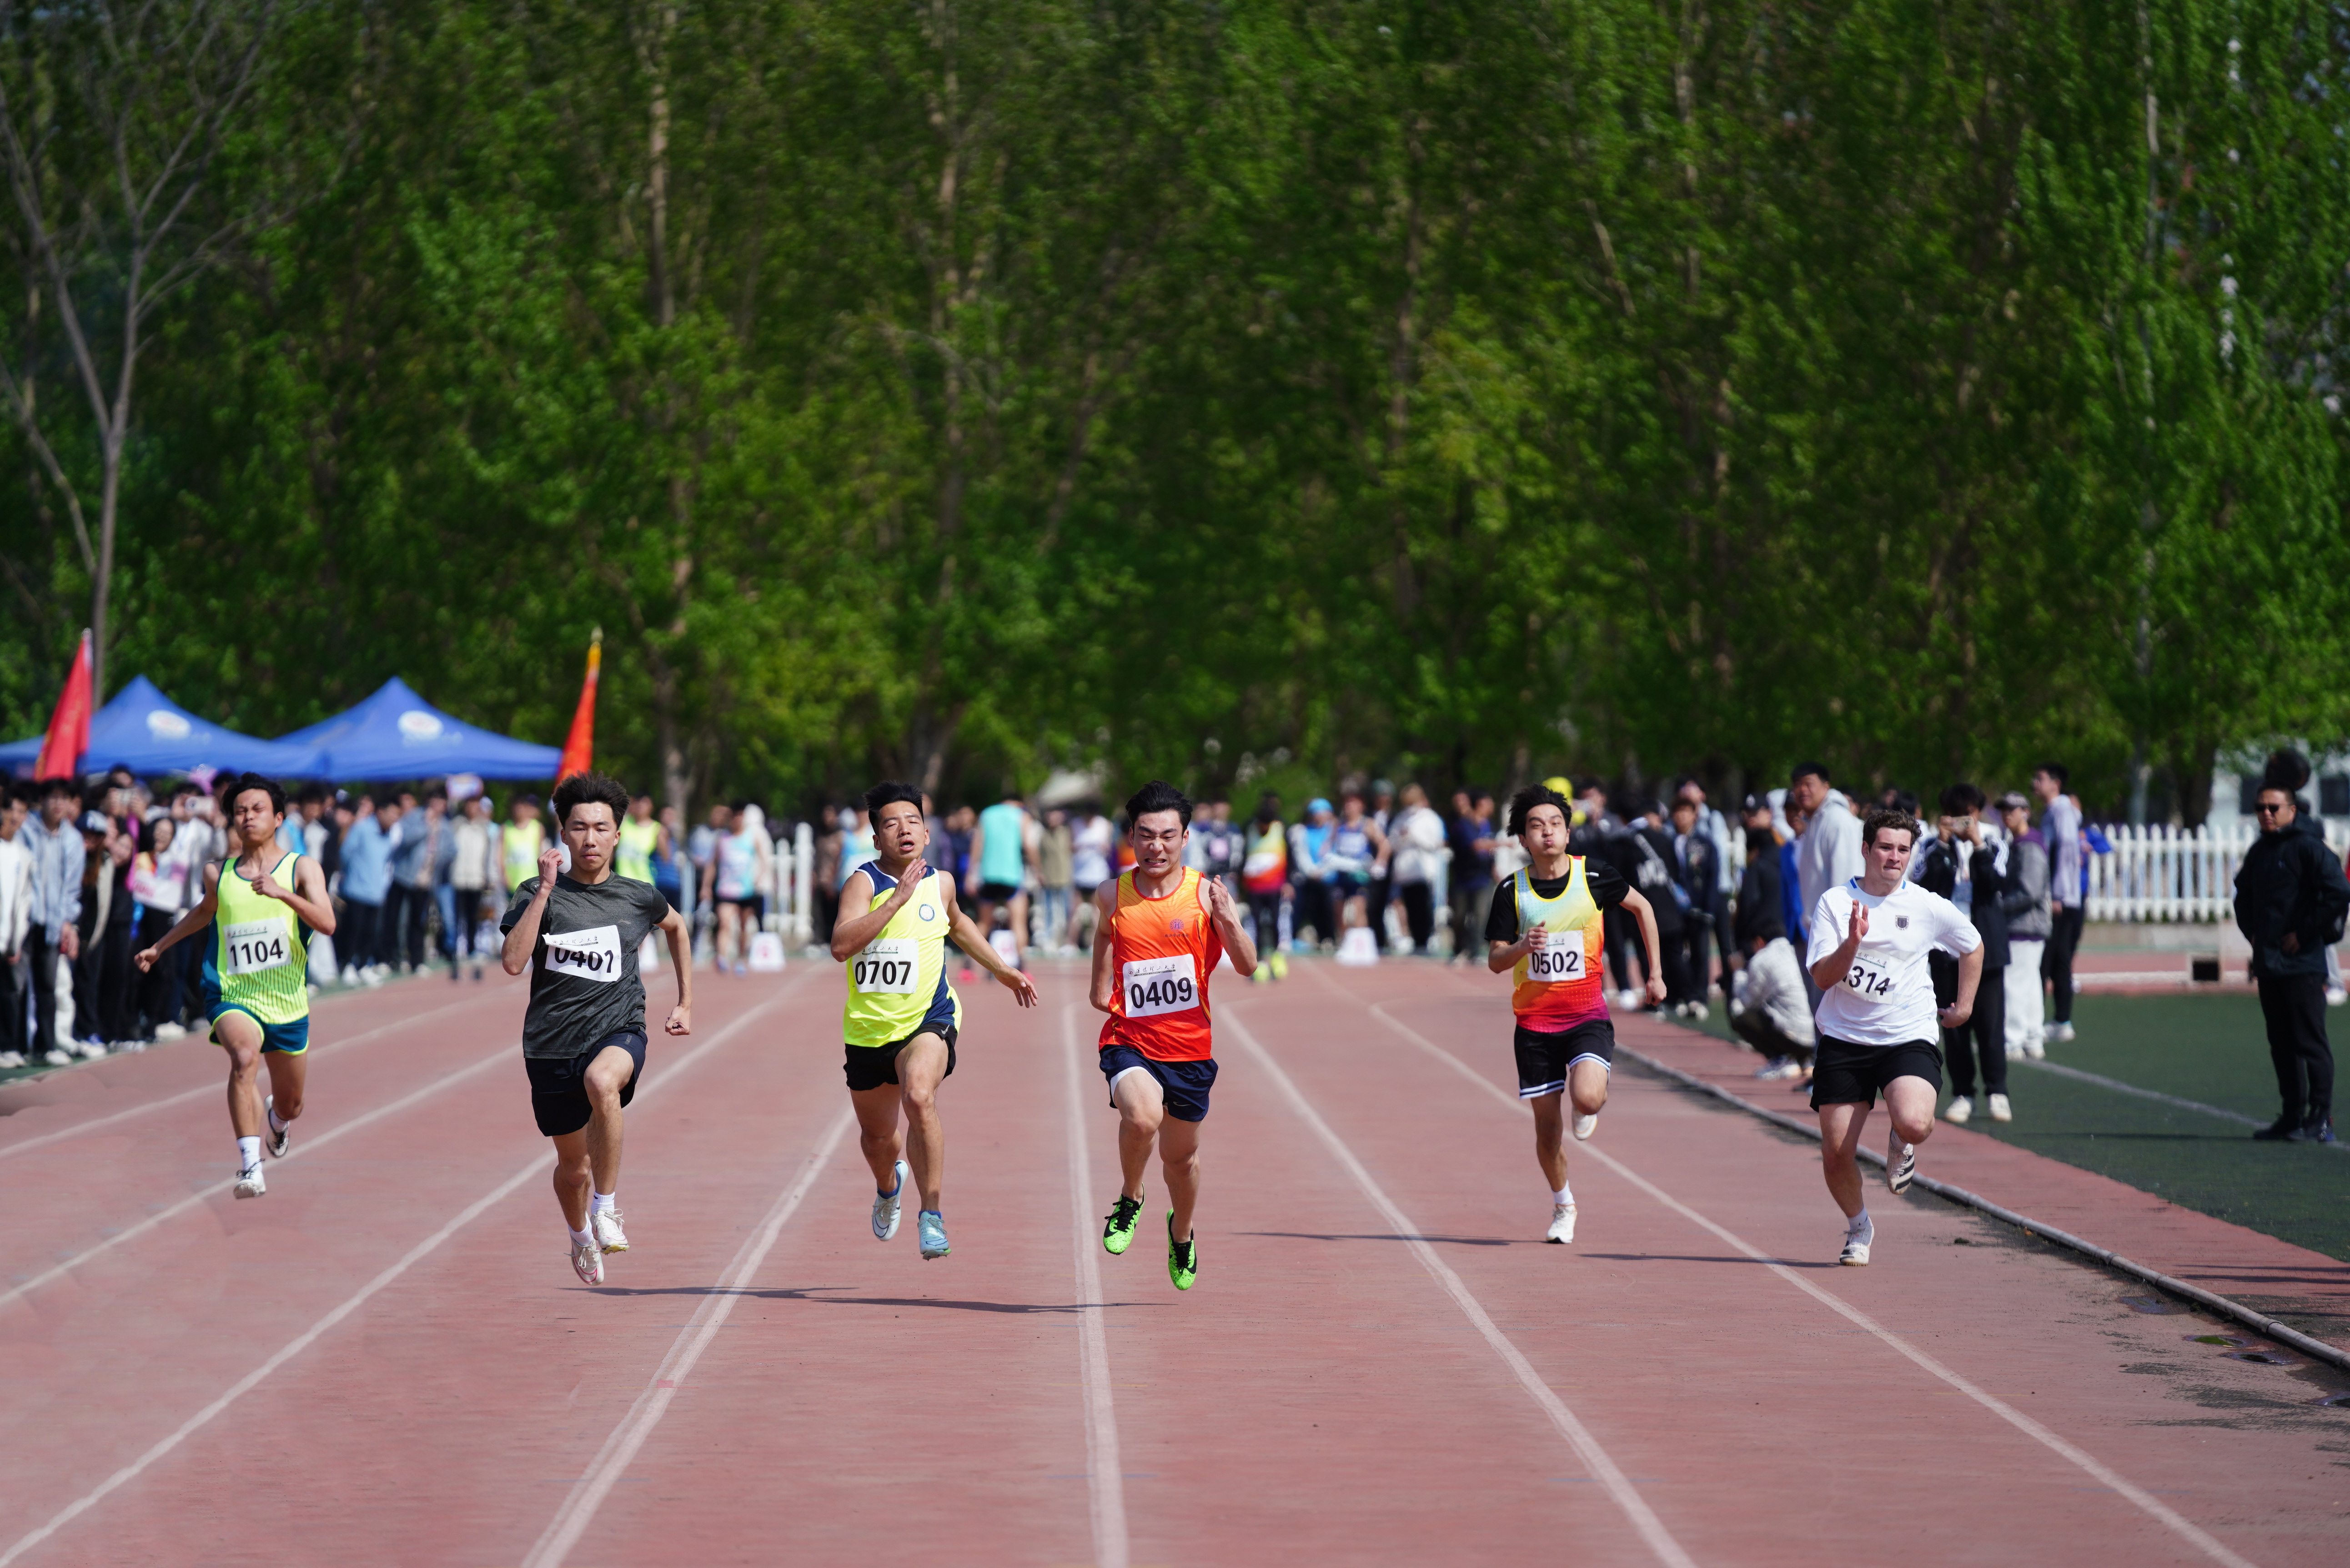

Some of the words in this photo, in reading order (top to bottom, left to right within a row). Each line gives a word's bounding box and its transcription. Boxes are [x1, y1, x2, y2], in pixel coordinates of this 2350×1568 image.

[230, 938, 283, 966] 1104
[554, 947, 613, 973] 0401
[1532, 950, 1578, 974] 0502
[855, 961, 911, 985] 0707
[1131, 977, 1192, 1008] 0409
